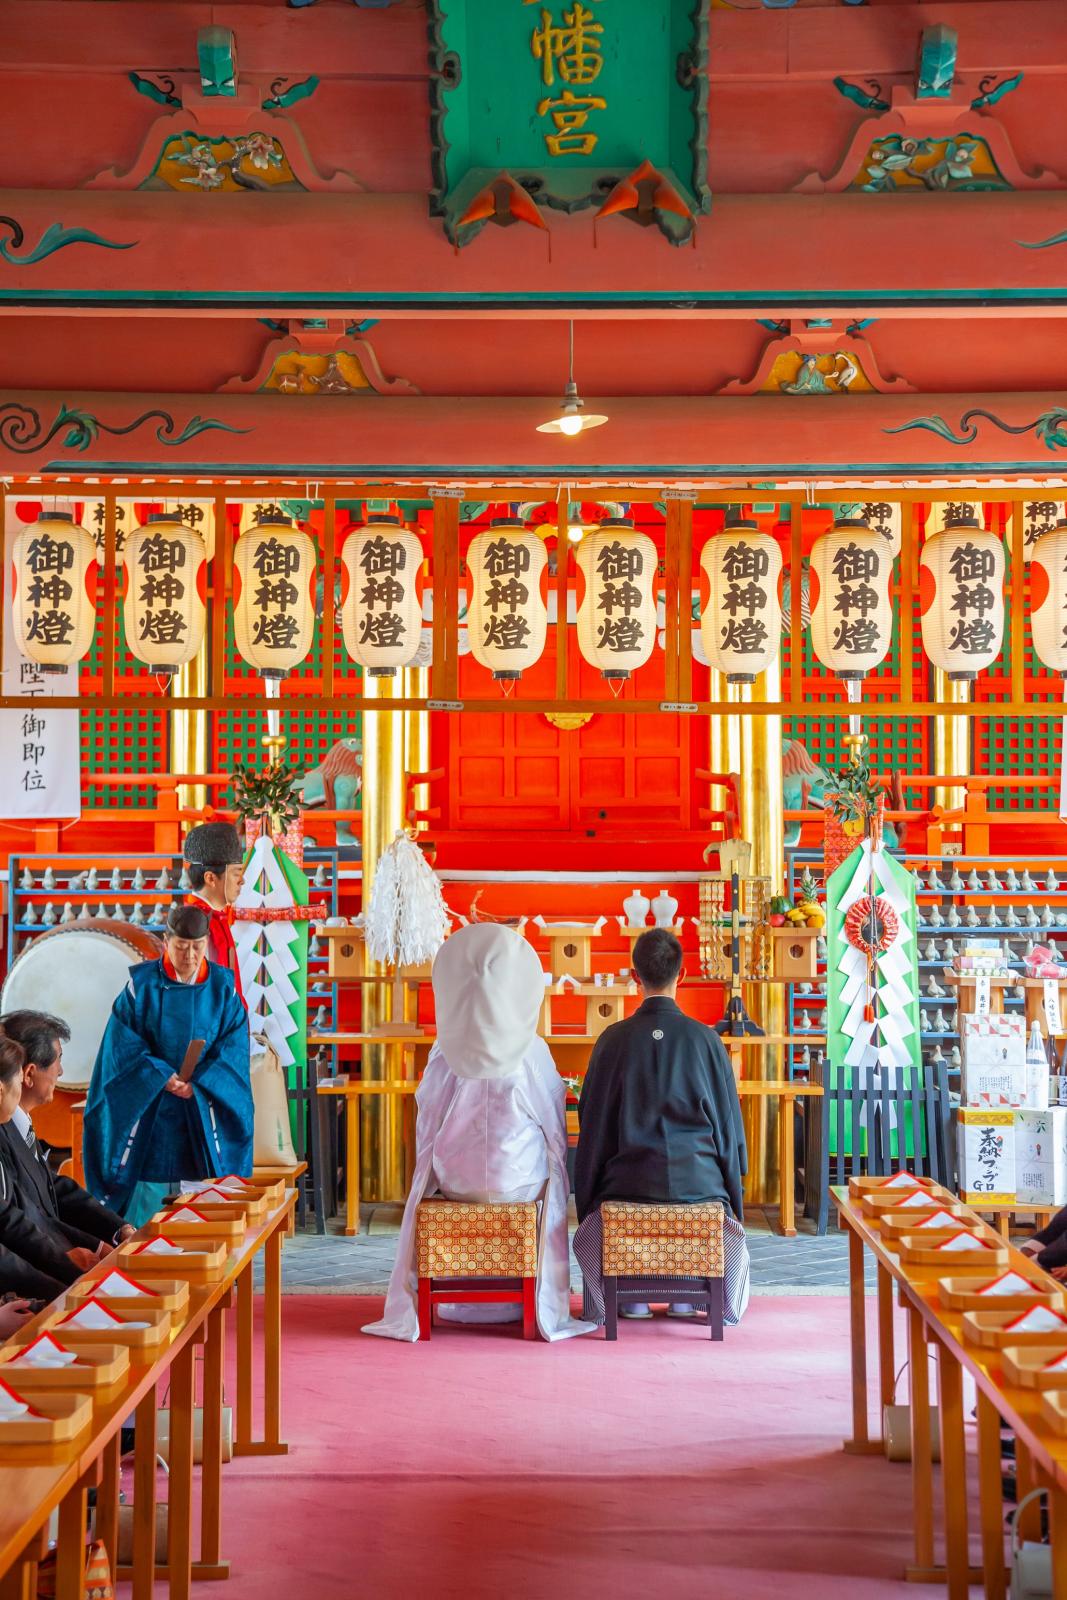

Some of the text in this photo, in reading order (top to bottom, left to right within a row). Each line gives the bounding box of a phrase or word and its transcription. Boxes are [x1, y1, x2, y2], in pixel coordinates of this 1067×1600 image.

[522, 0, 608, 157] 幡宮
[26, 534, 75, 645] 御神燈
[139, 533, 186, 645] 御神燈
[253, 537, 300, 649] 御神燈
[359, 535, 407, 648] 御神燈
[483, 537, 532, 650] 御神燈
[596, 540, 645, 653] 御神燈
[720, 541, 769, 654] 御神燈
[832, 542, 881, 654] 御神燈
[948, 542, 996, 654] 御神燈
